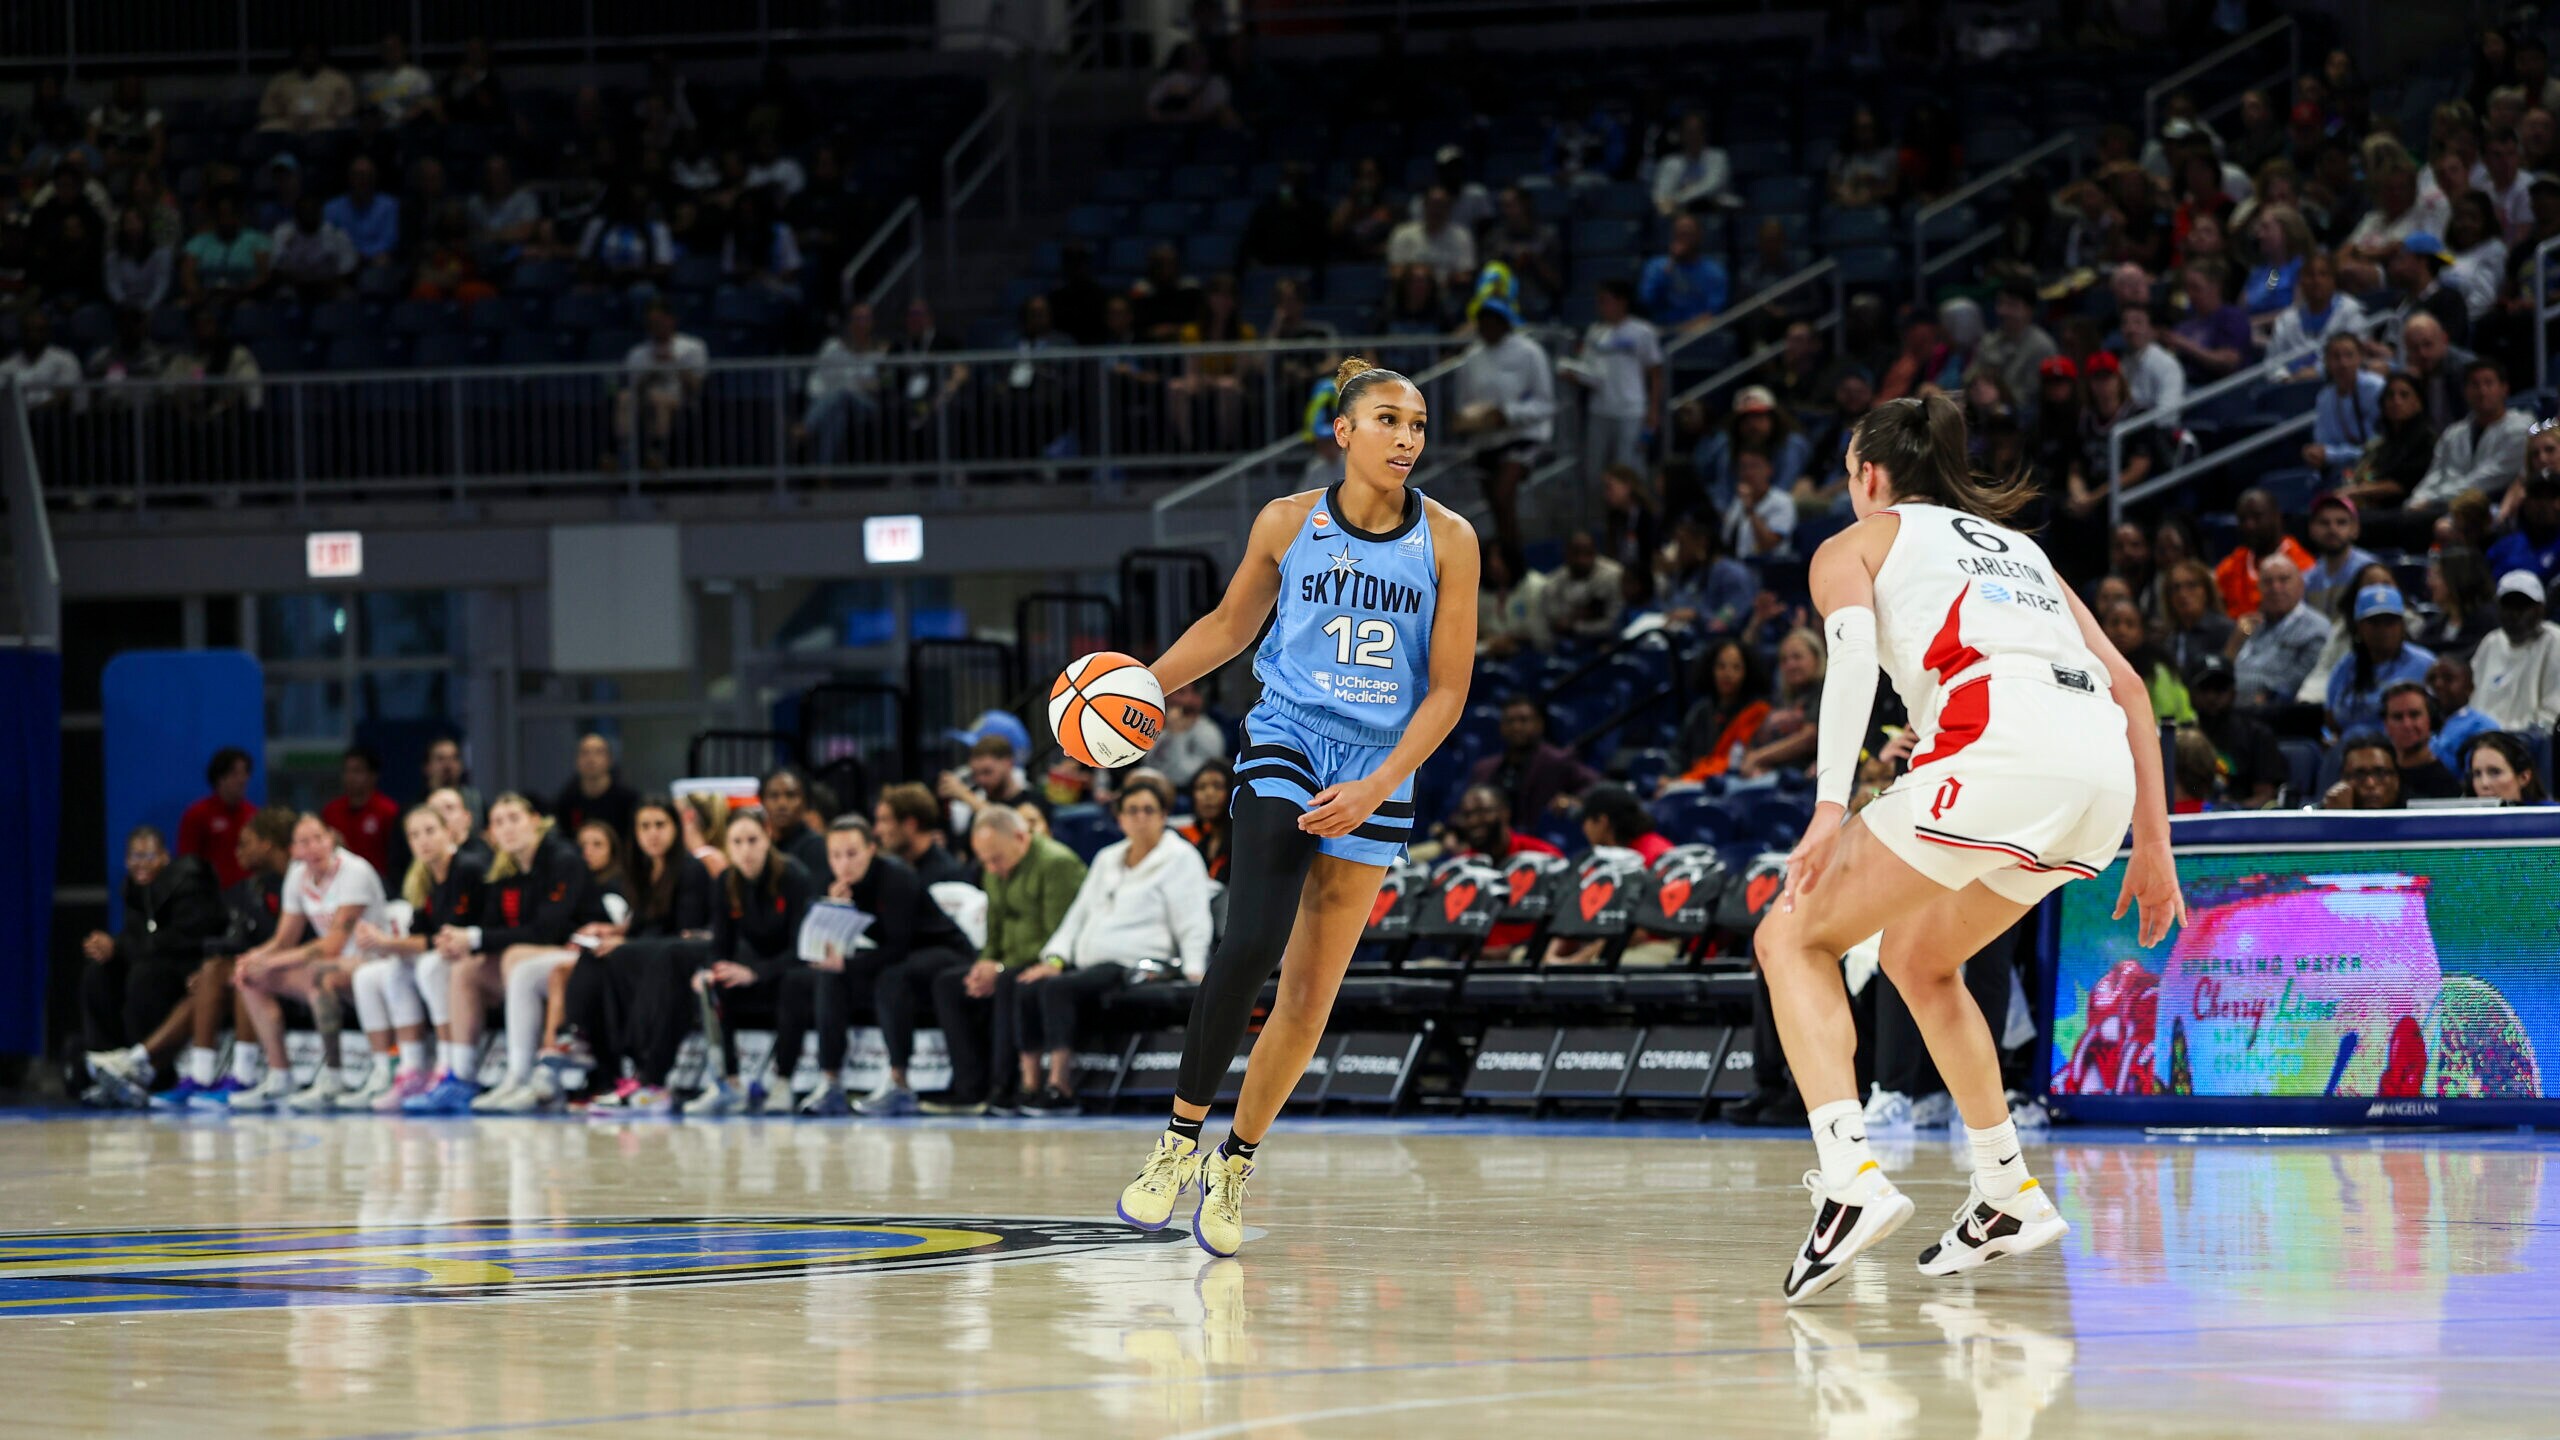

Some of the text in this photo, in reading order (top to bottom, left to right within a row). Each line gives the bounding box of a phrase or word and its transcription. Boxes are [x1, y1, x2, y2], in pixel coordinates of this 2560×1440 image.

[1951, 517, 2009, 553] 6
[1957, 557, 2047, 588] CARLETON
[1302, 568, 1422, 614] SKYTOWN
[2016, 590, 2060, 615] AT&T
[1321, 614, 1396, 670] 12
[1335, 674, 1399, 692] UChicago
[1333, 688, 1398, 704] Medicine
[2295, 955, 2363, 974] WATER
[2383, 1102, 2439, 1116] MAGELLAN
